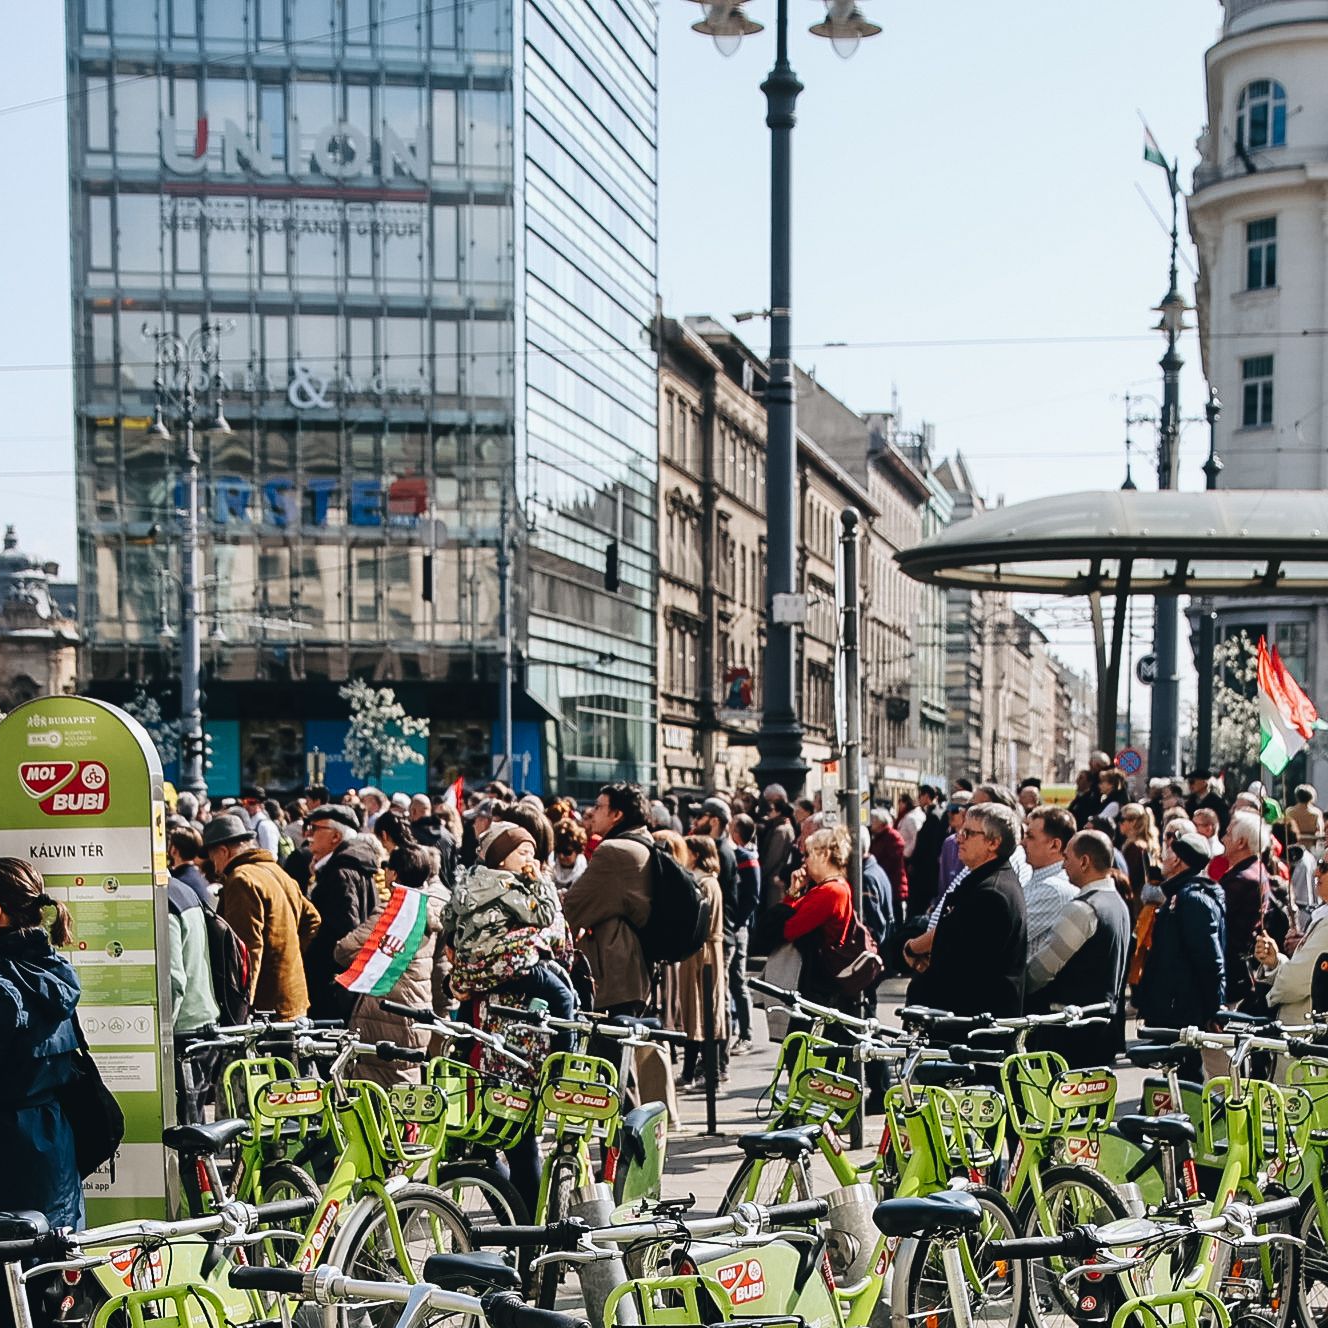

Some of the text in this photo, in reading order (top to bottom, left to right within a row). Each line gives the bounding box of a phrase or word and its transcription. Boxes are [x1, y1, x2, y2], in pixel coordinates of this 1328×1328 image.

[161, 112, 428, 184] UNION
[288, 362, 335, 409] &
[48, 716, 97, 725] BUDAPEST
[26, 766, 56, 781] MOL
[53, 793, 105, 811] BUBI
[29, 842, 104, 858] KÁLVIN TÉR
[832, 1087, 853, 1099] BUBI
[1087, 1082, 1108, 1092] BUBI
[584, 1096, 607, 1107] BUBI
[95, 1183, 110, 1191] app
[720, 1268, 737, 1283] MOL
[735, 1281, 764, 1302] BUBI
